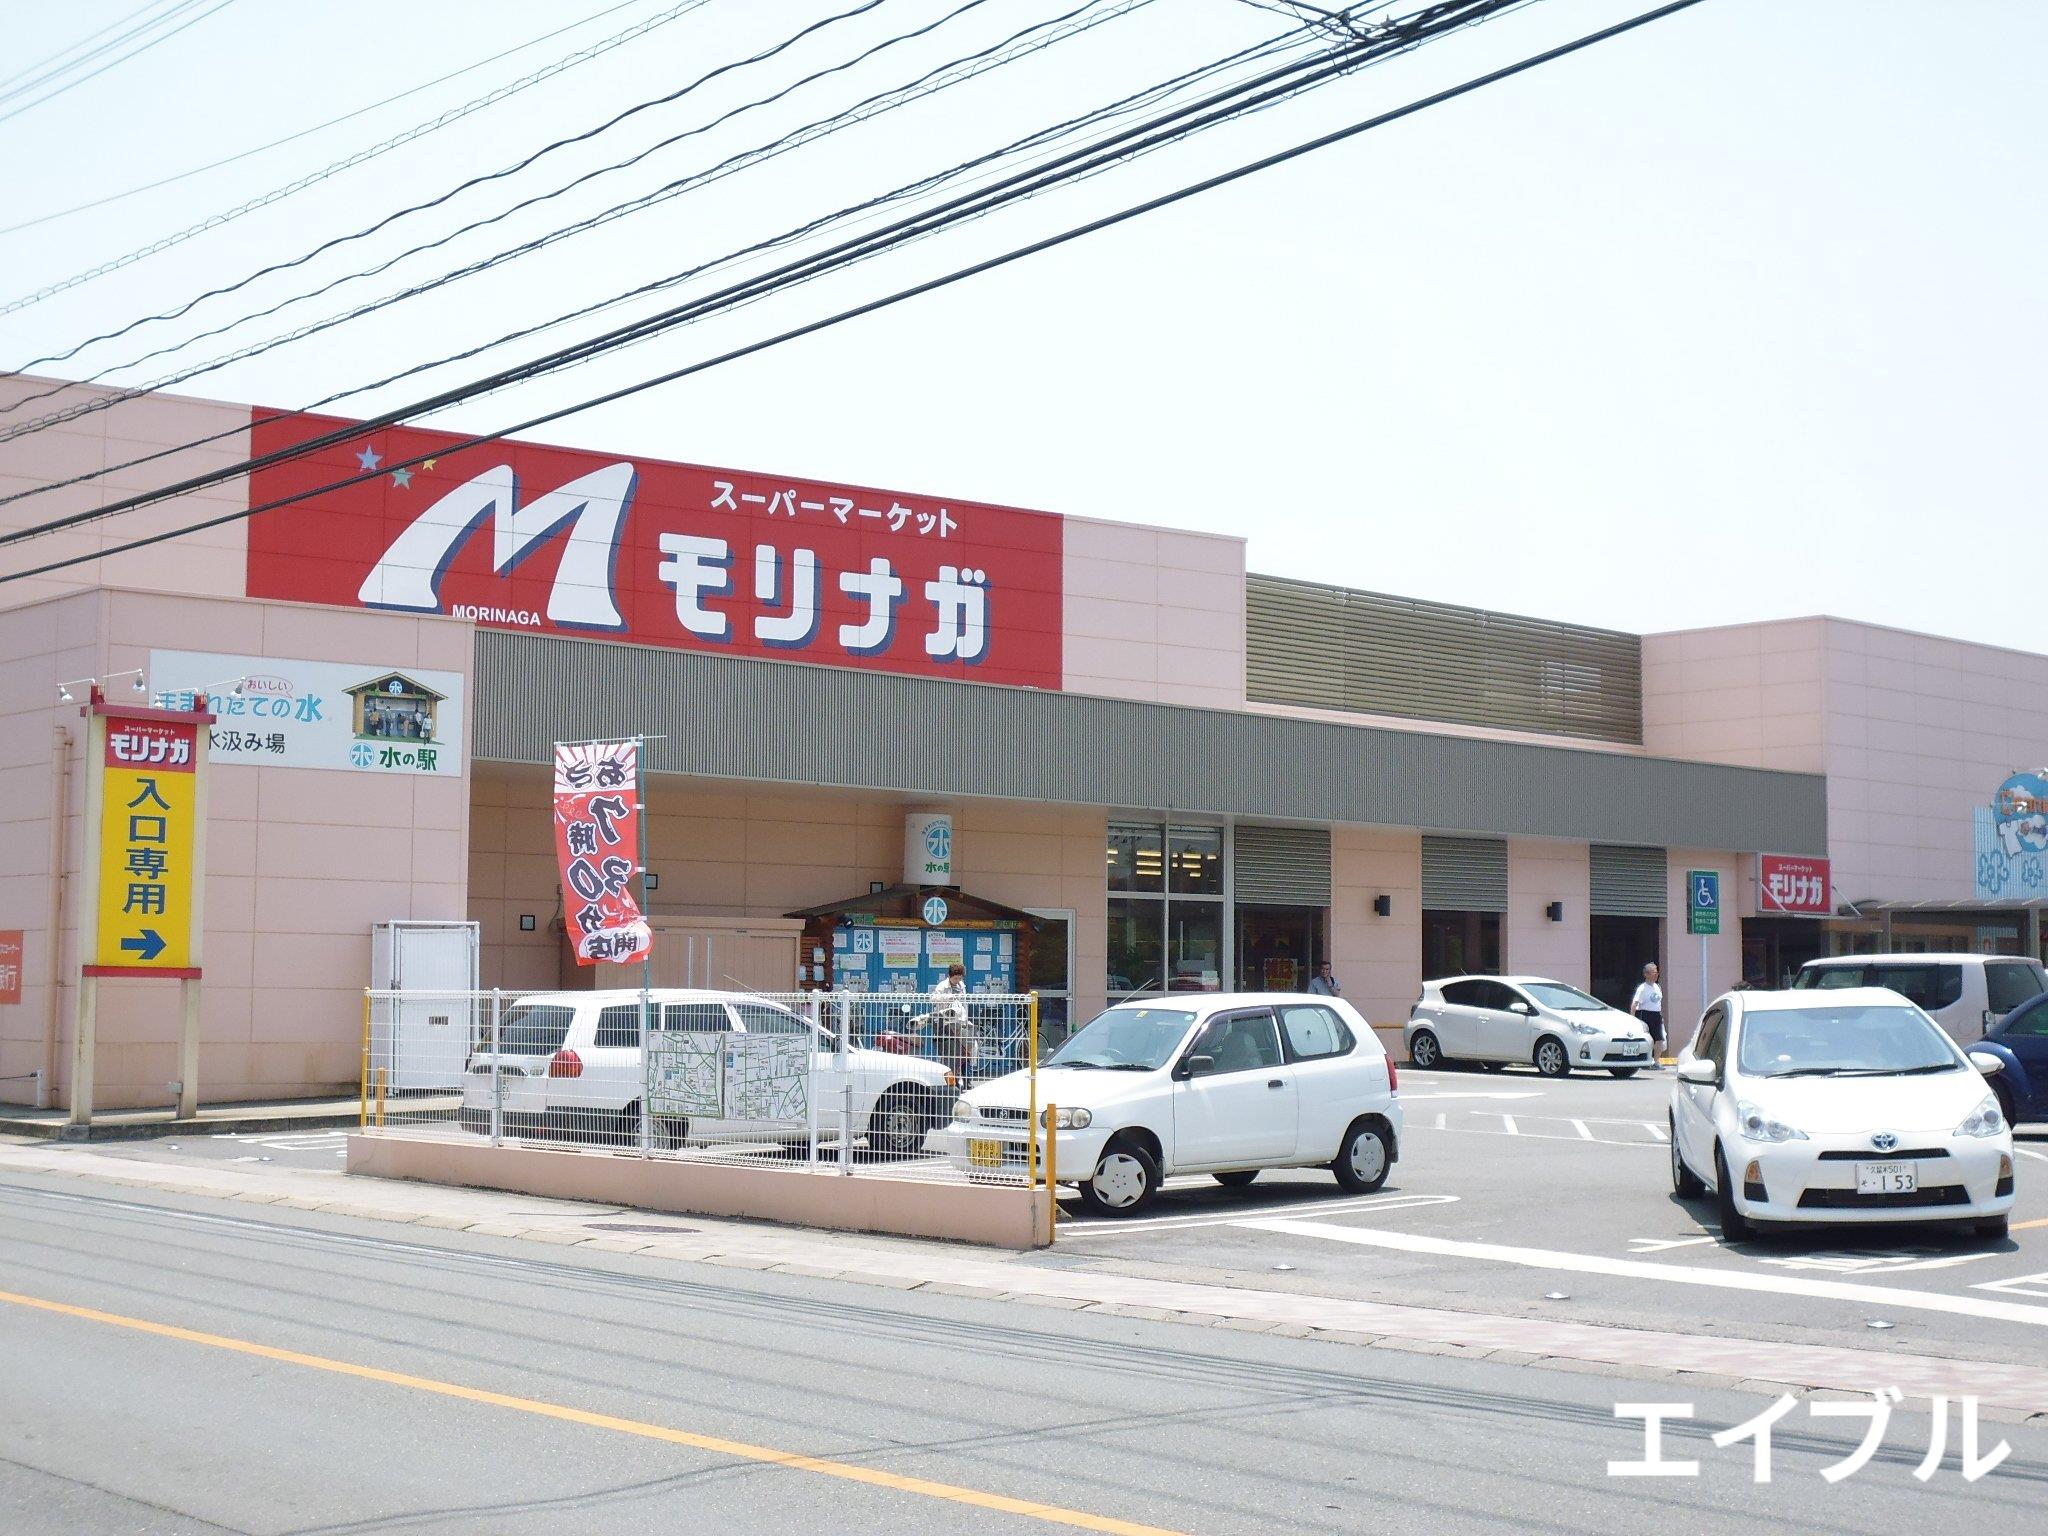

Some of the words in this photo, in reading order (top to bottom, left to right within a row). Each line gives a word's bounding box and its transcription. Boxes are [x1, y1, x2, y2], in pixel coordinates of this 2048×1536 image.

[710, 480, 958, 538] スーパーマーケット
[658, 532, 988, 662] モリナガ
[452, 604, 541, 626] MORINAGA
[247, 680, 288, 691] おいしい
[110, 733, 190, 764] モリナガ
[379, 746, 437, 771] 水の駅
[122, 777, 172, 915] 入口専用
[1769, 873, 1823, 906] モリナガ
